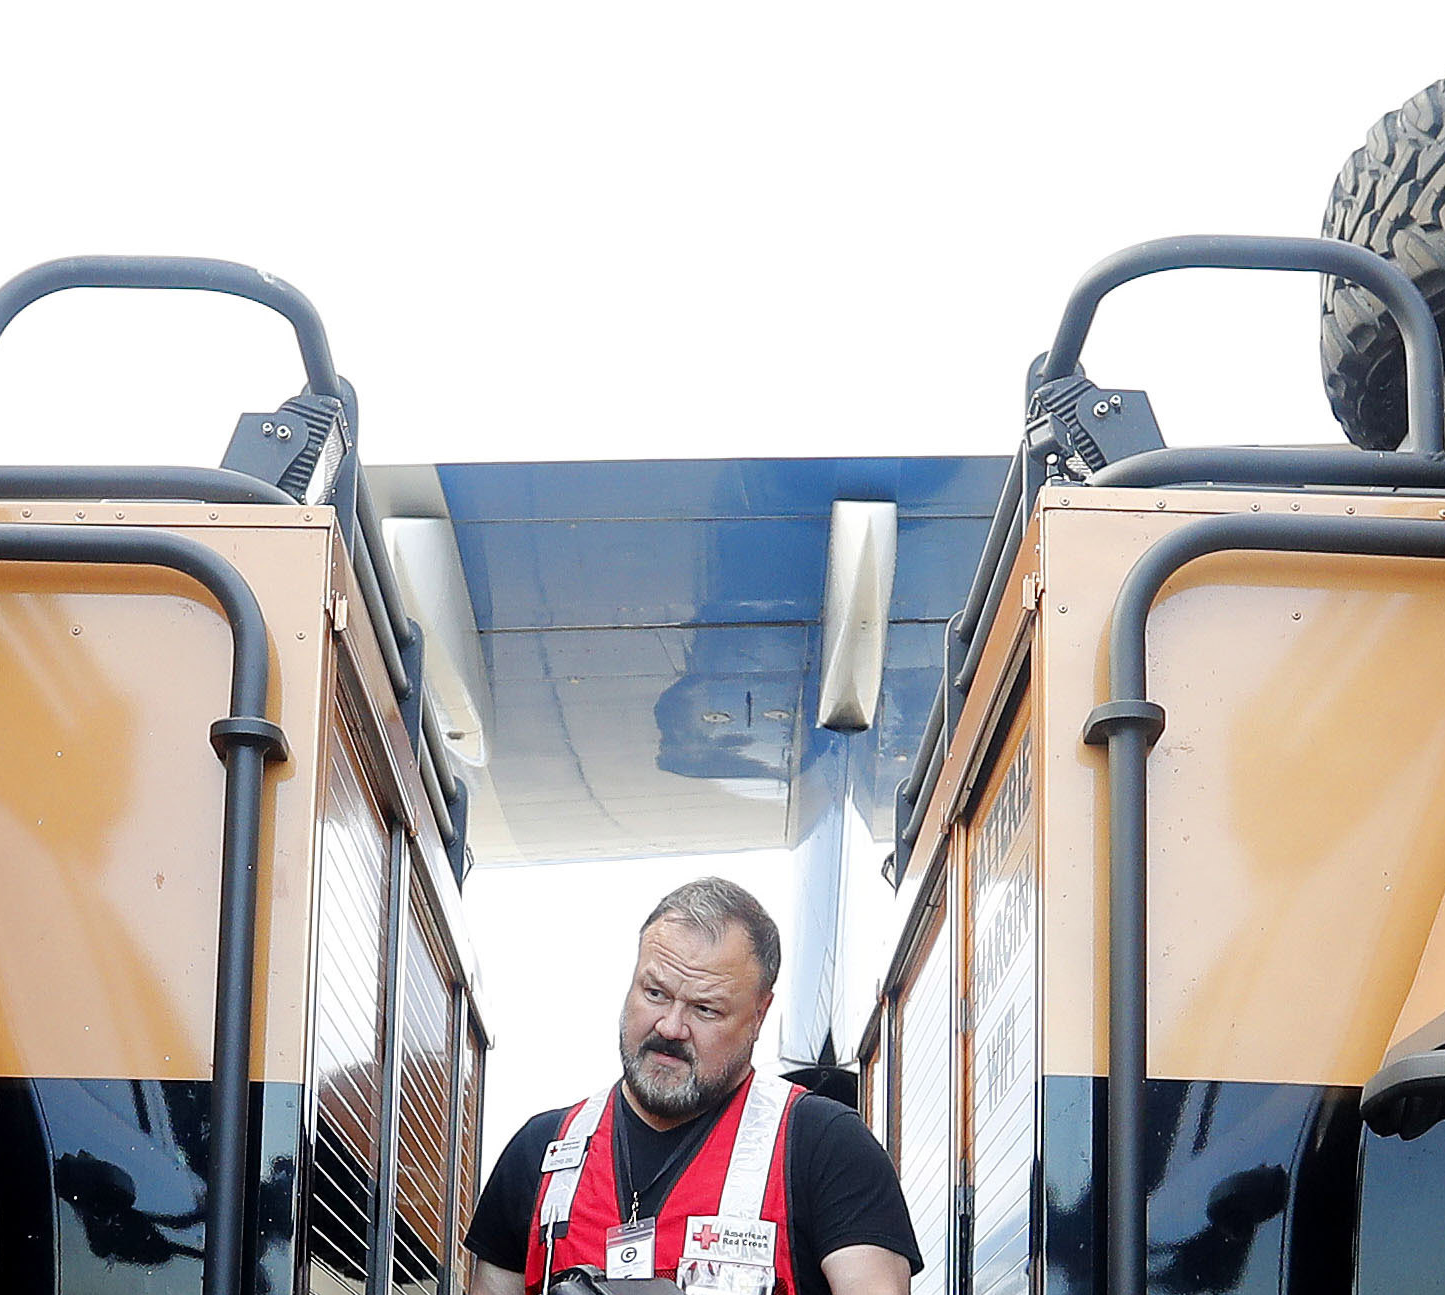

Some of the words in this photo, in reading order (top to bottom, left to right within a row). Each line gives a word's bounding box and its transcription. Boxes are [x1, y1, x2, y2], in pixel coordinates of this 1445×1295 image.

[724, 1229, 768, 1241] American
[722, 1238, 739, 1246] Red
[742, 1240, 768, 1249] Cross
